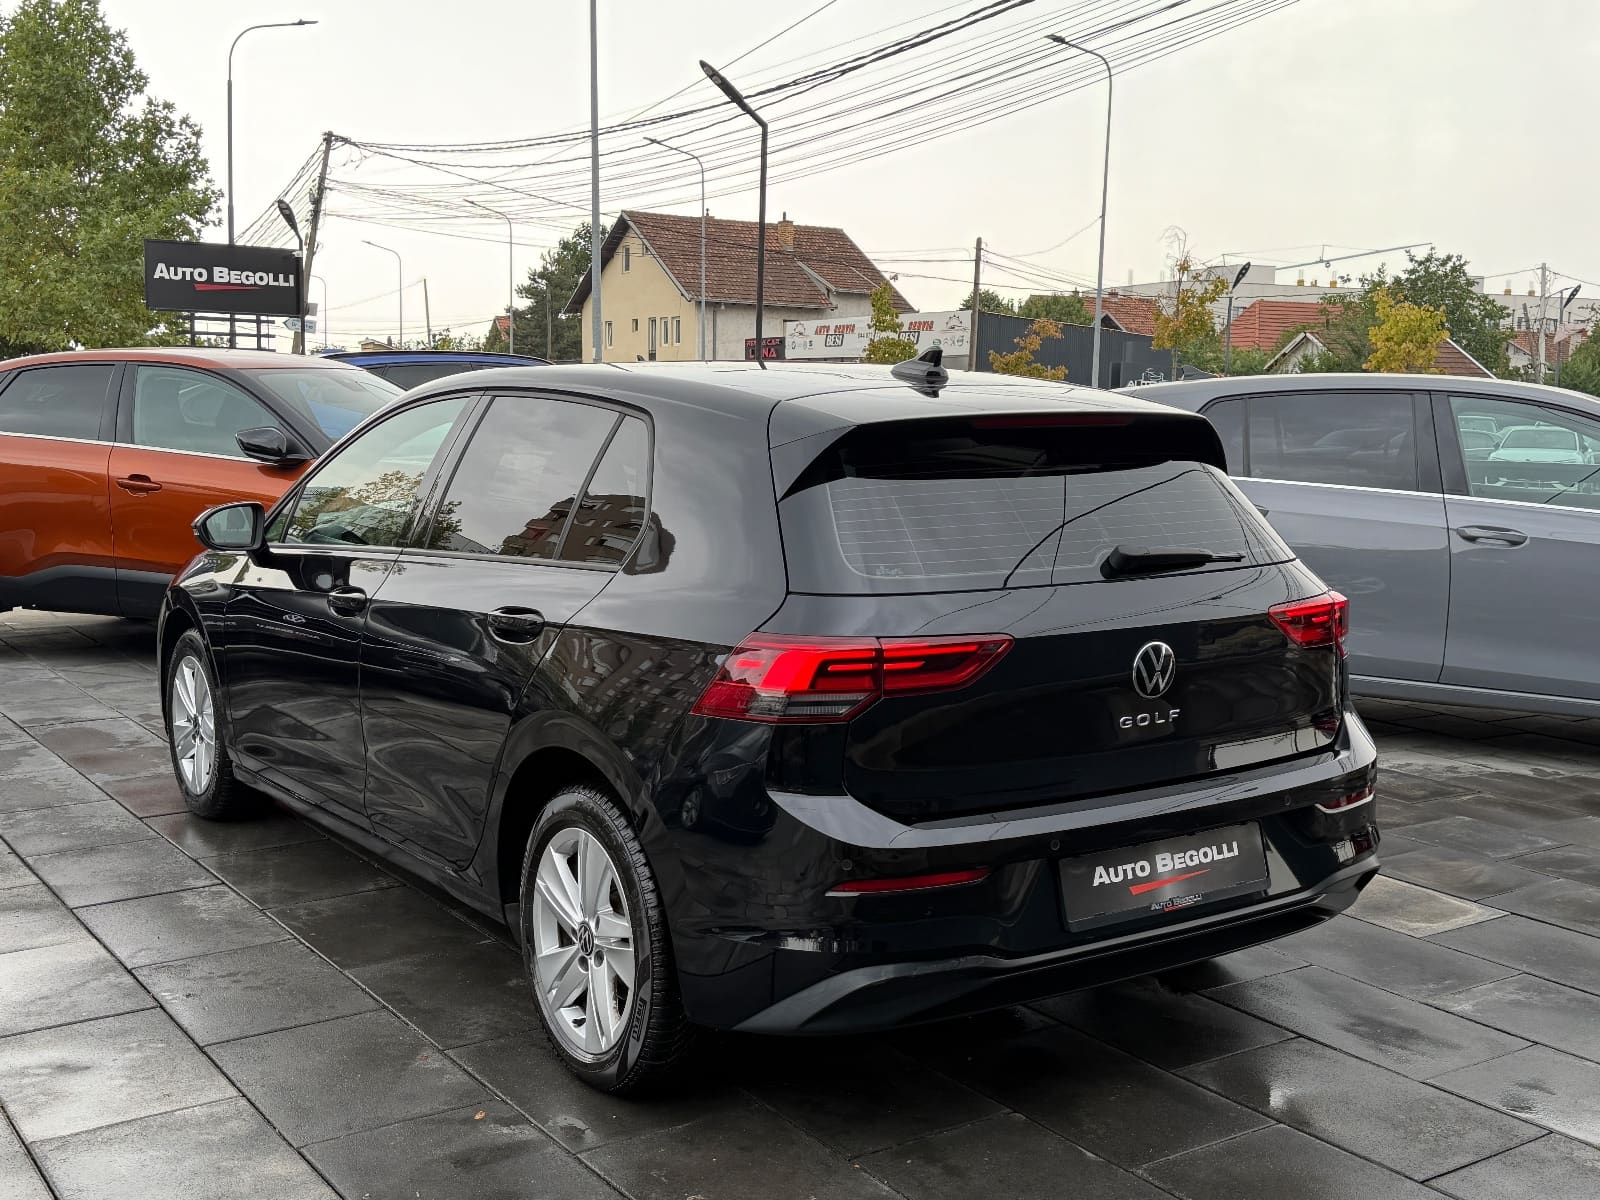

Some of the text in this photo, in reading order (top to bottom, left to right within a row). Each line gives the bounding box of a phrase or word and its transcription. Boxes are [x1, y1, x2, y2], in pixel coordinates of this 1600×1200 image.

[153, 262, 295, 287] AUTO BEGOLLI
[749, 348, 777, 358] LNA
[1120, 709, 1180, 728] GOLF
[1092, 841, 1239, 887] AUTO BEGOLLI
[1150, 900, 1172, 911] AUTO
